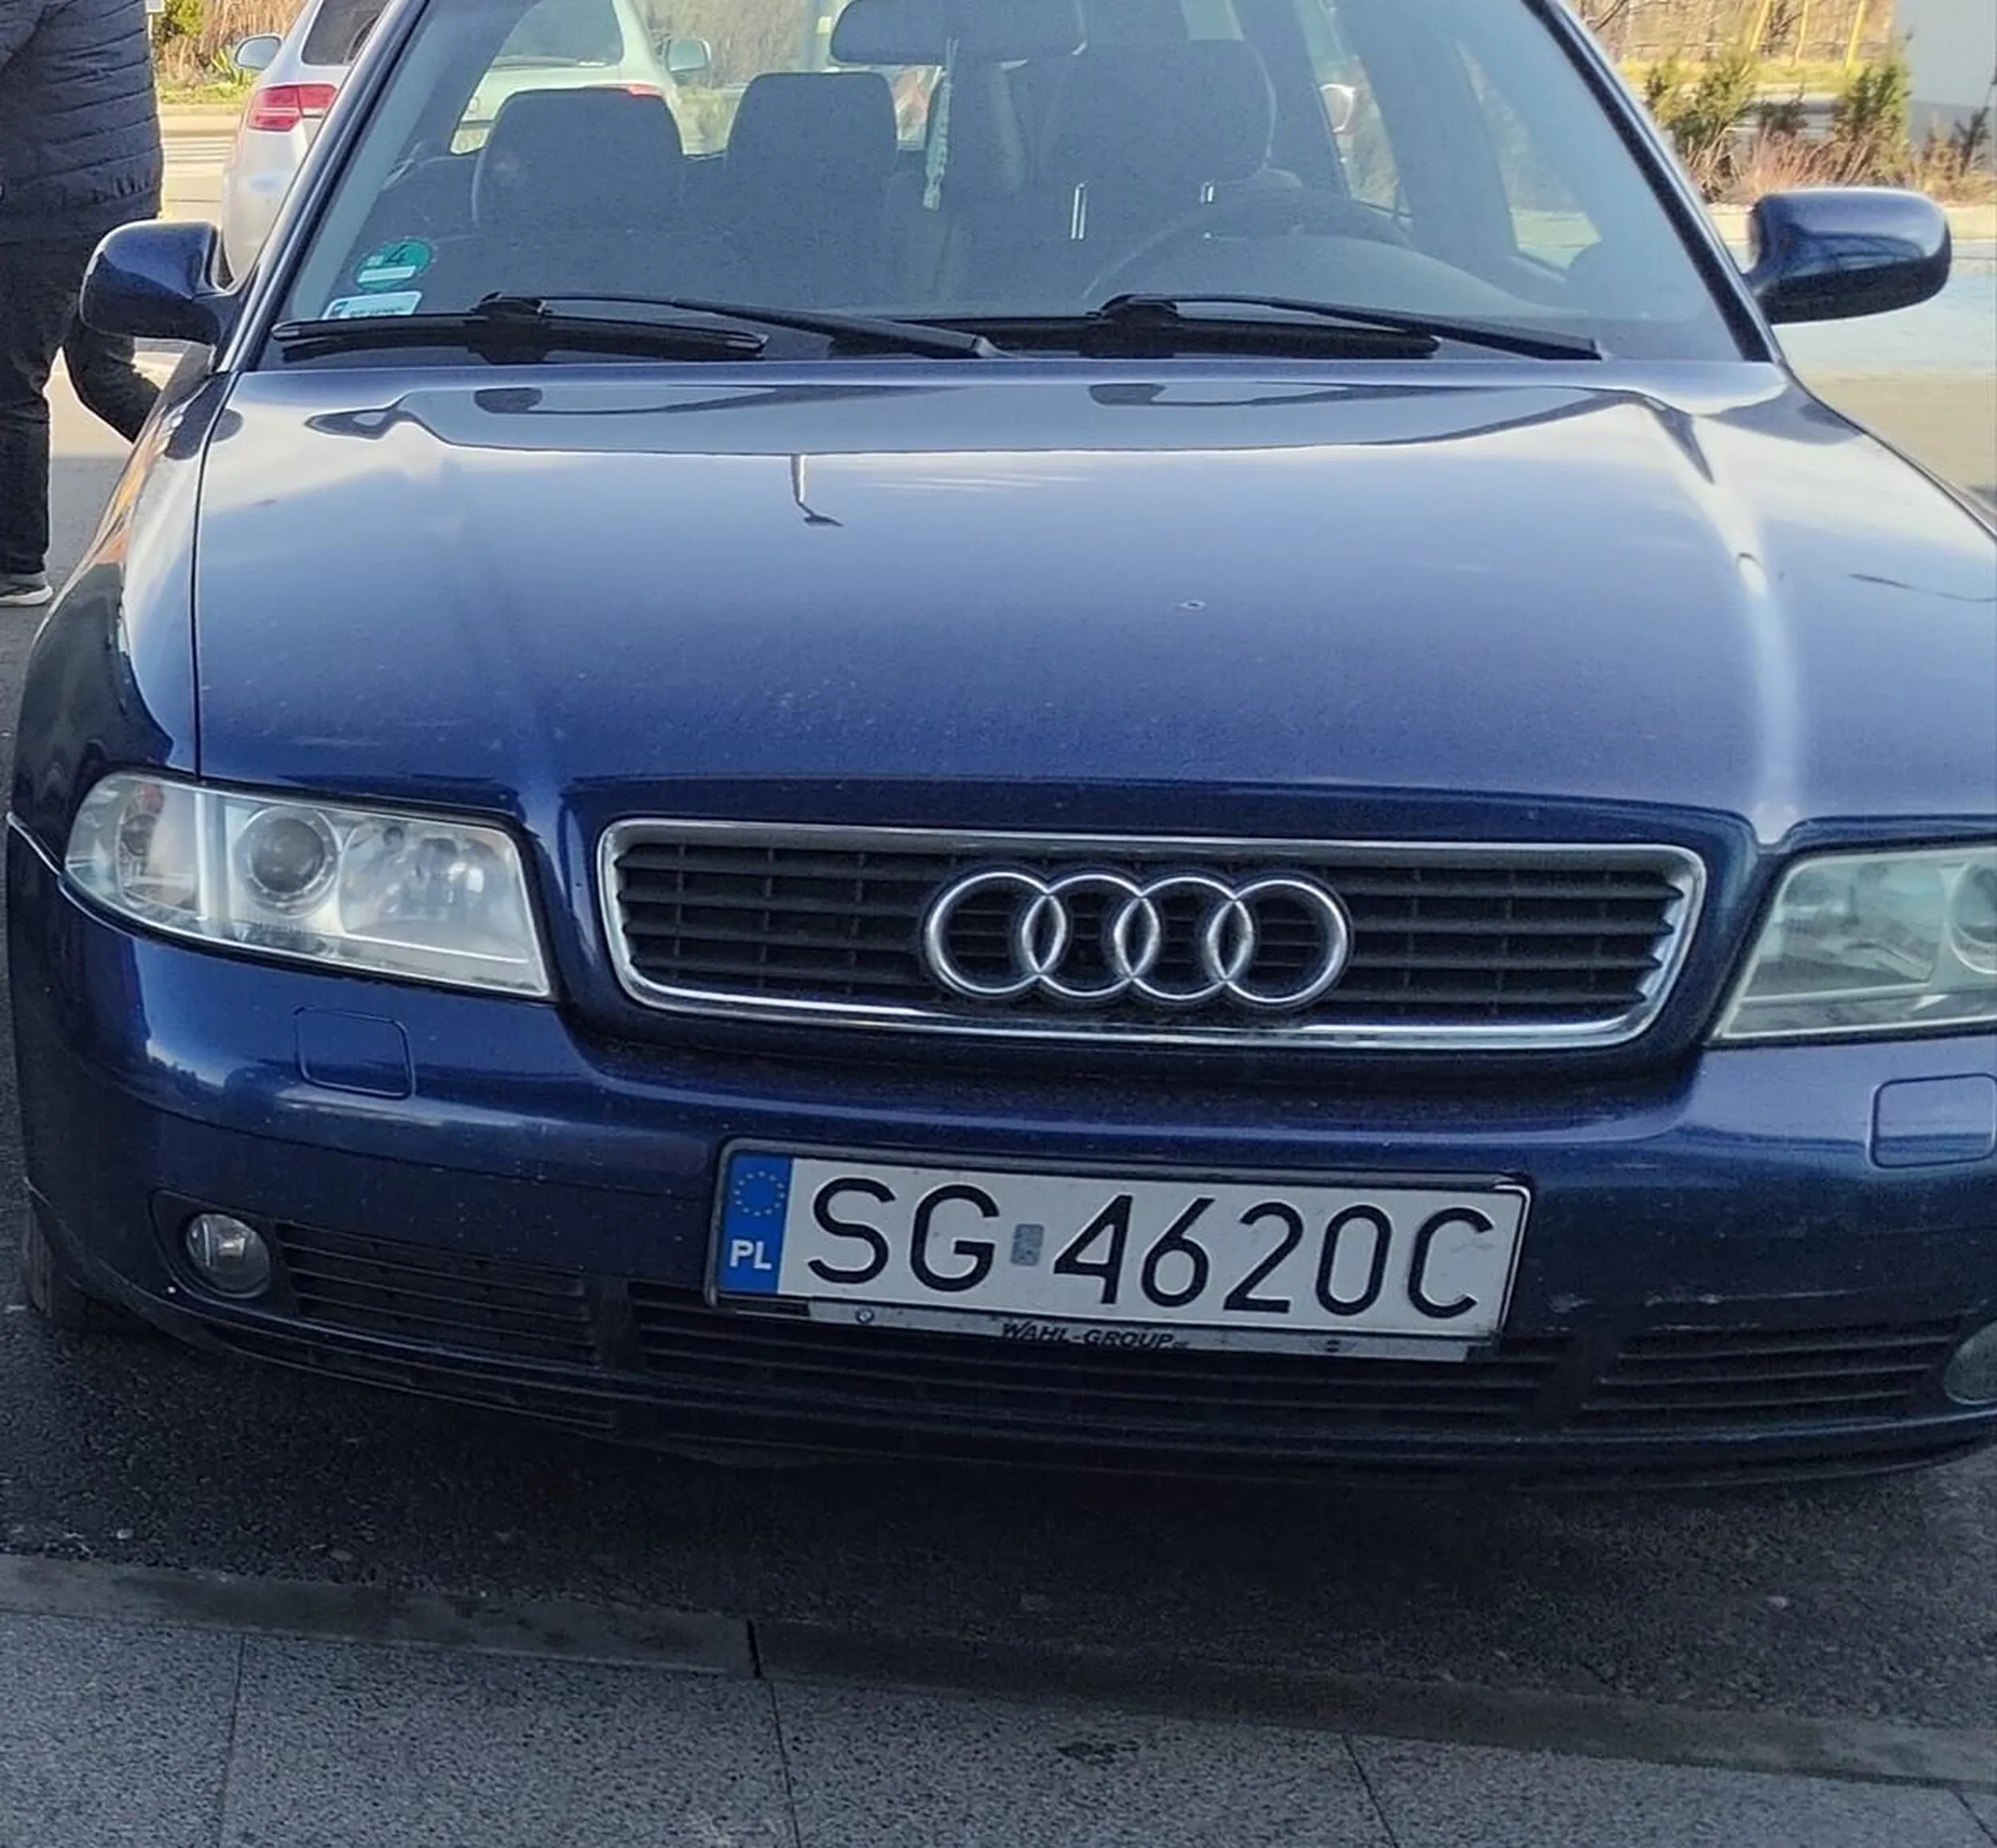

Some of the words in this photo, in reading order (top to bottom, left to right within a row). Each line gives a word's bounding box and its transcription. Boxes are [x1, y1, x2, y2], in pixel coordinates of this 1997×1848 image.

[384, 244, 410, 264] 4
[729, 1239, 773, 1271] PL
[806, 1176, 1000, 1292] SG
[1052, 1195, 1495, 1319] 4620C
